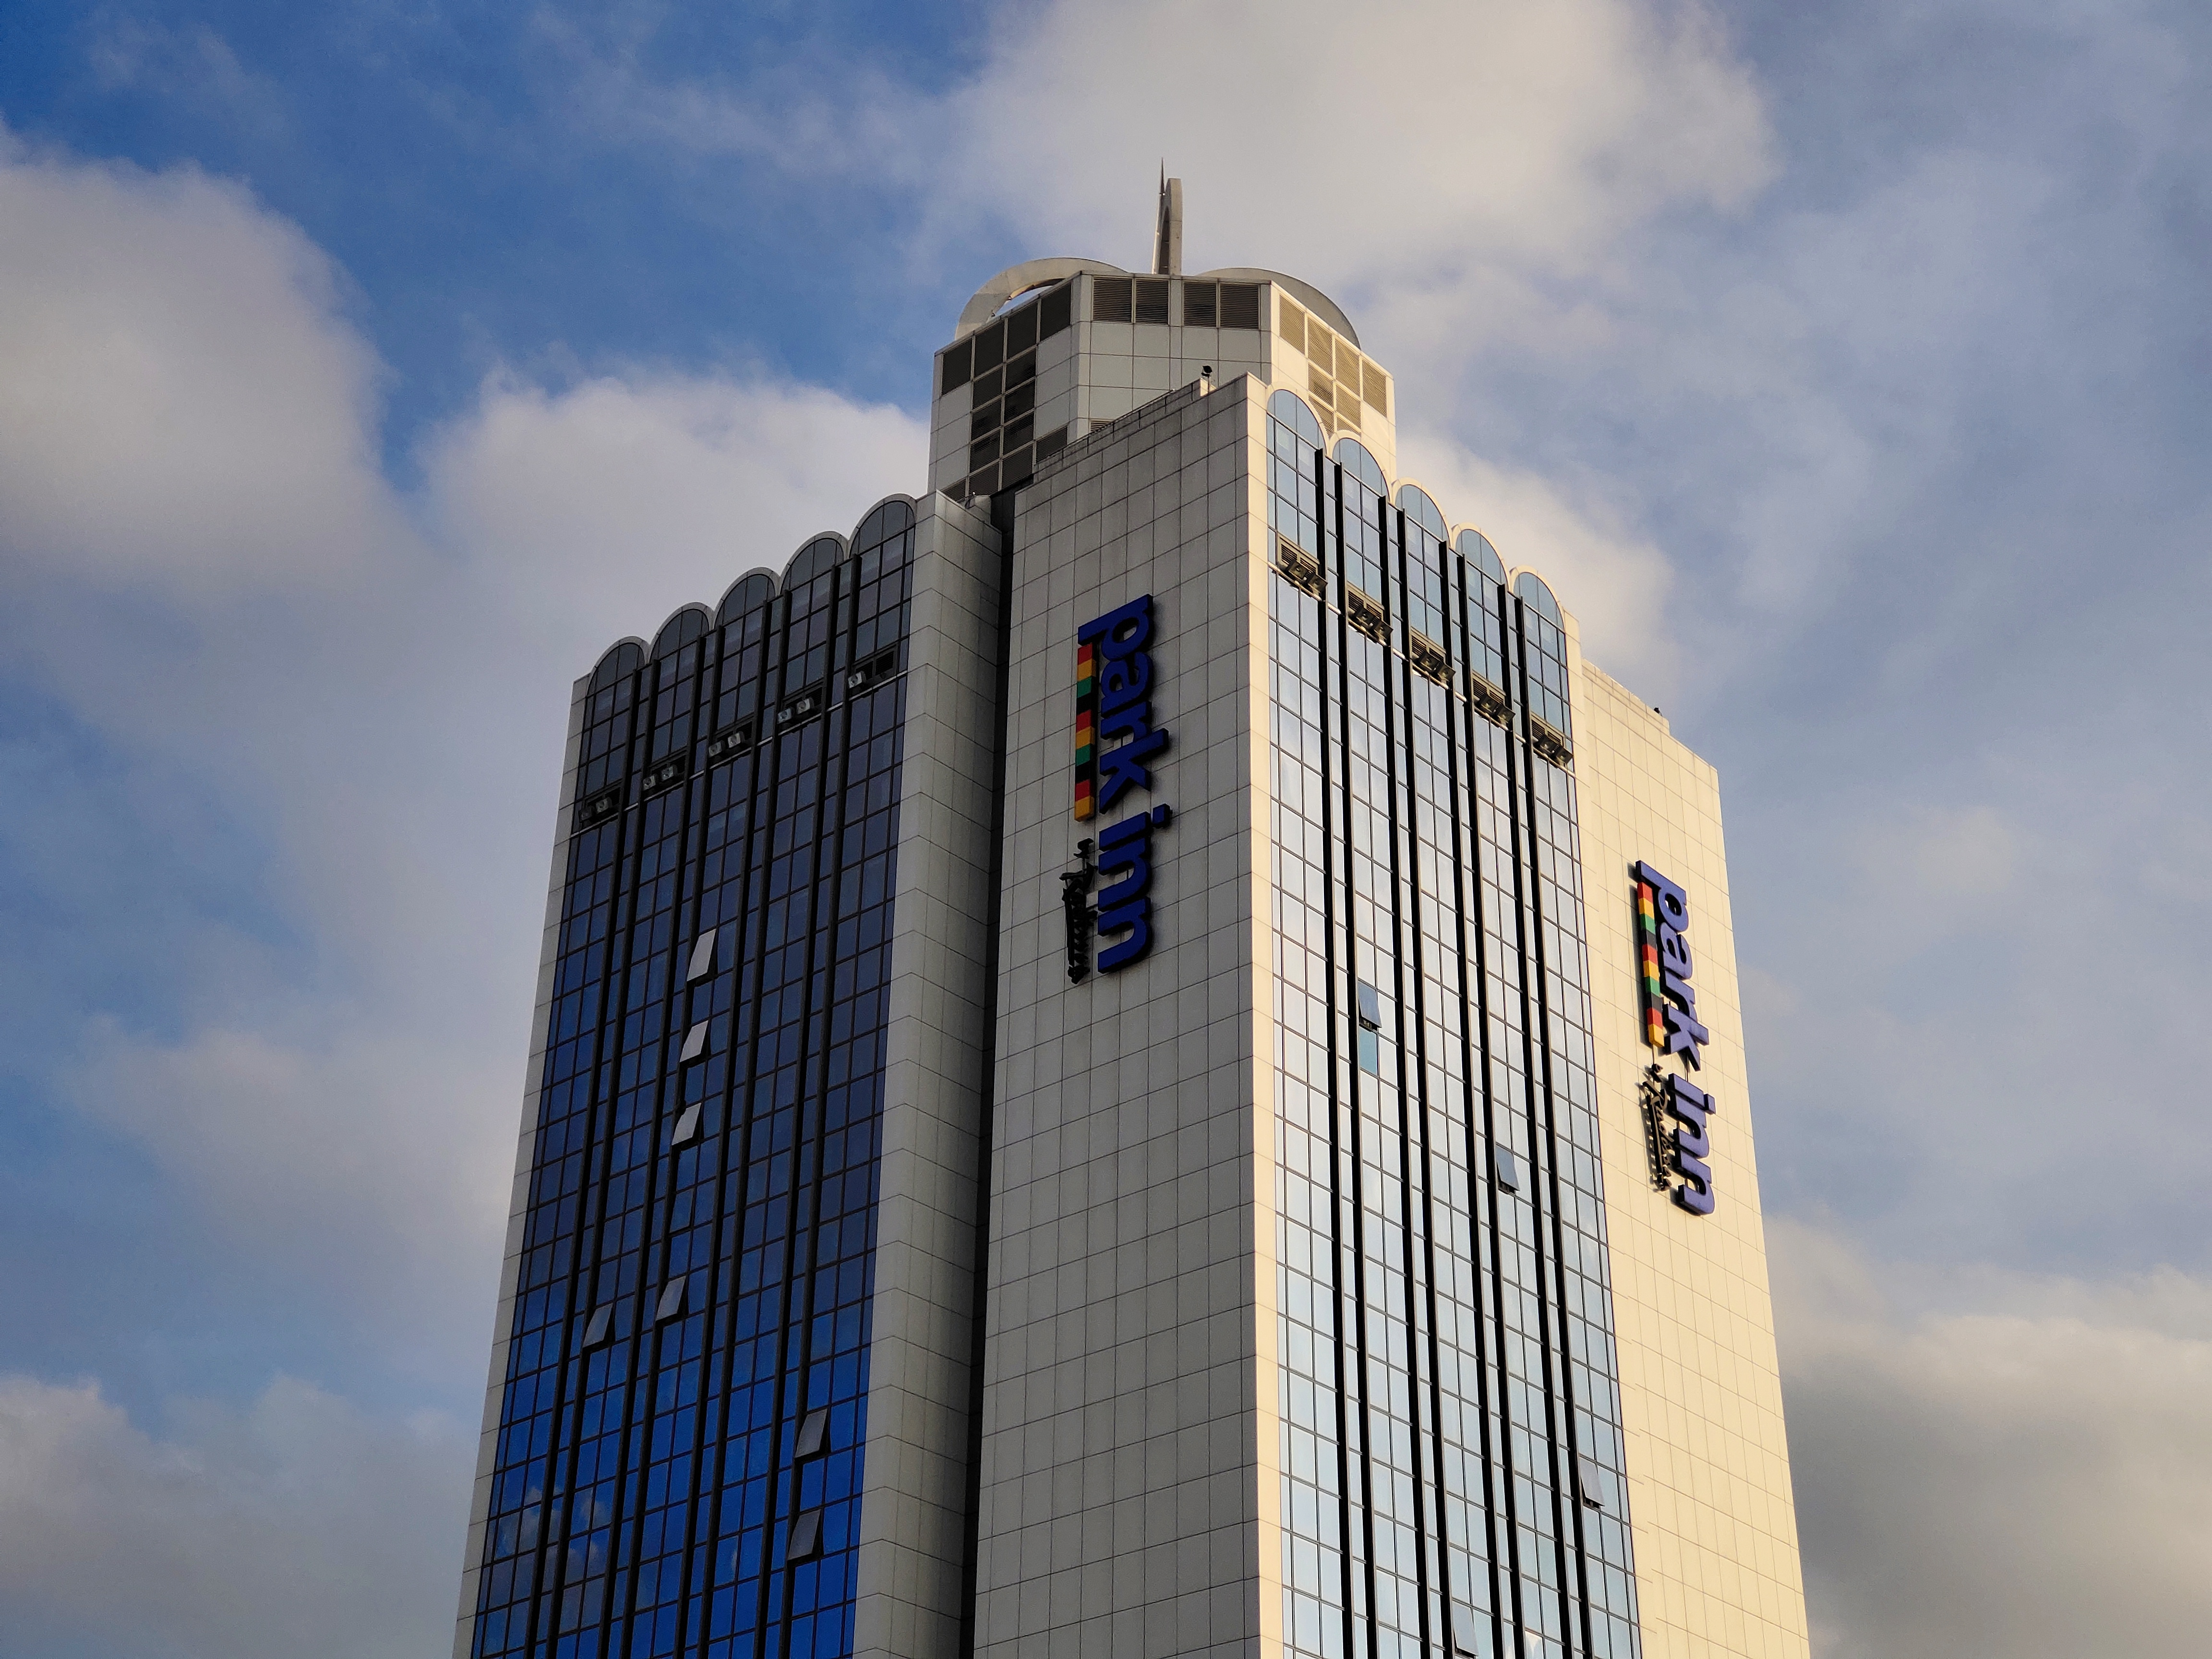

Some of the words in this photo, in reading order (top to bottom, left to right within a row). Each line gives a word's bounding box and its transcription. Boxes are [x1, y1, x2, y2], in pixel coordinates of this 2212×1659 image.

[1078, 593, 1169, 815] park
[1097, 803, 1172, 974] inn
[1635, 860, 1709, 1071] park
[1668, 1072, 1716, 1215] inn
